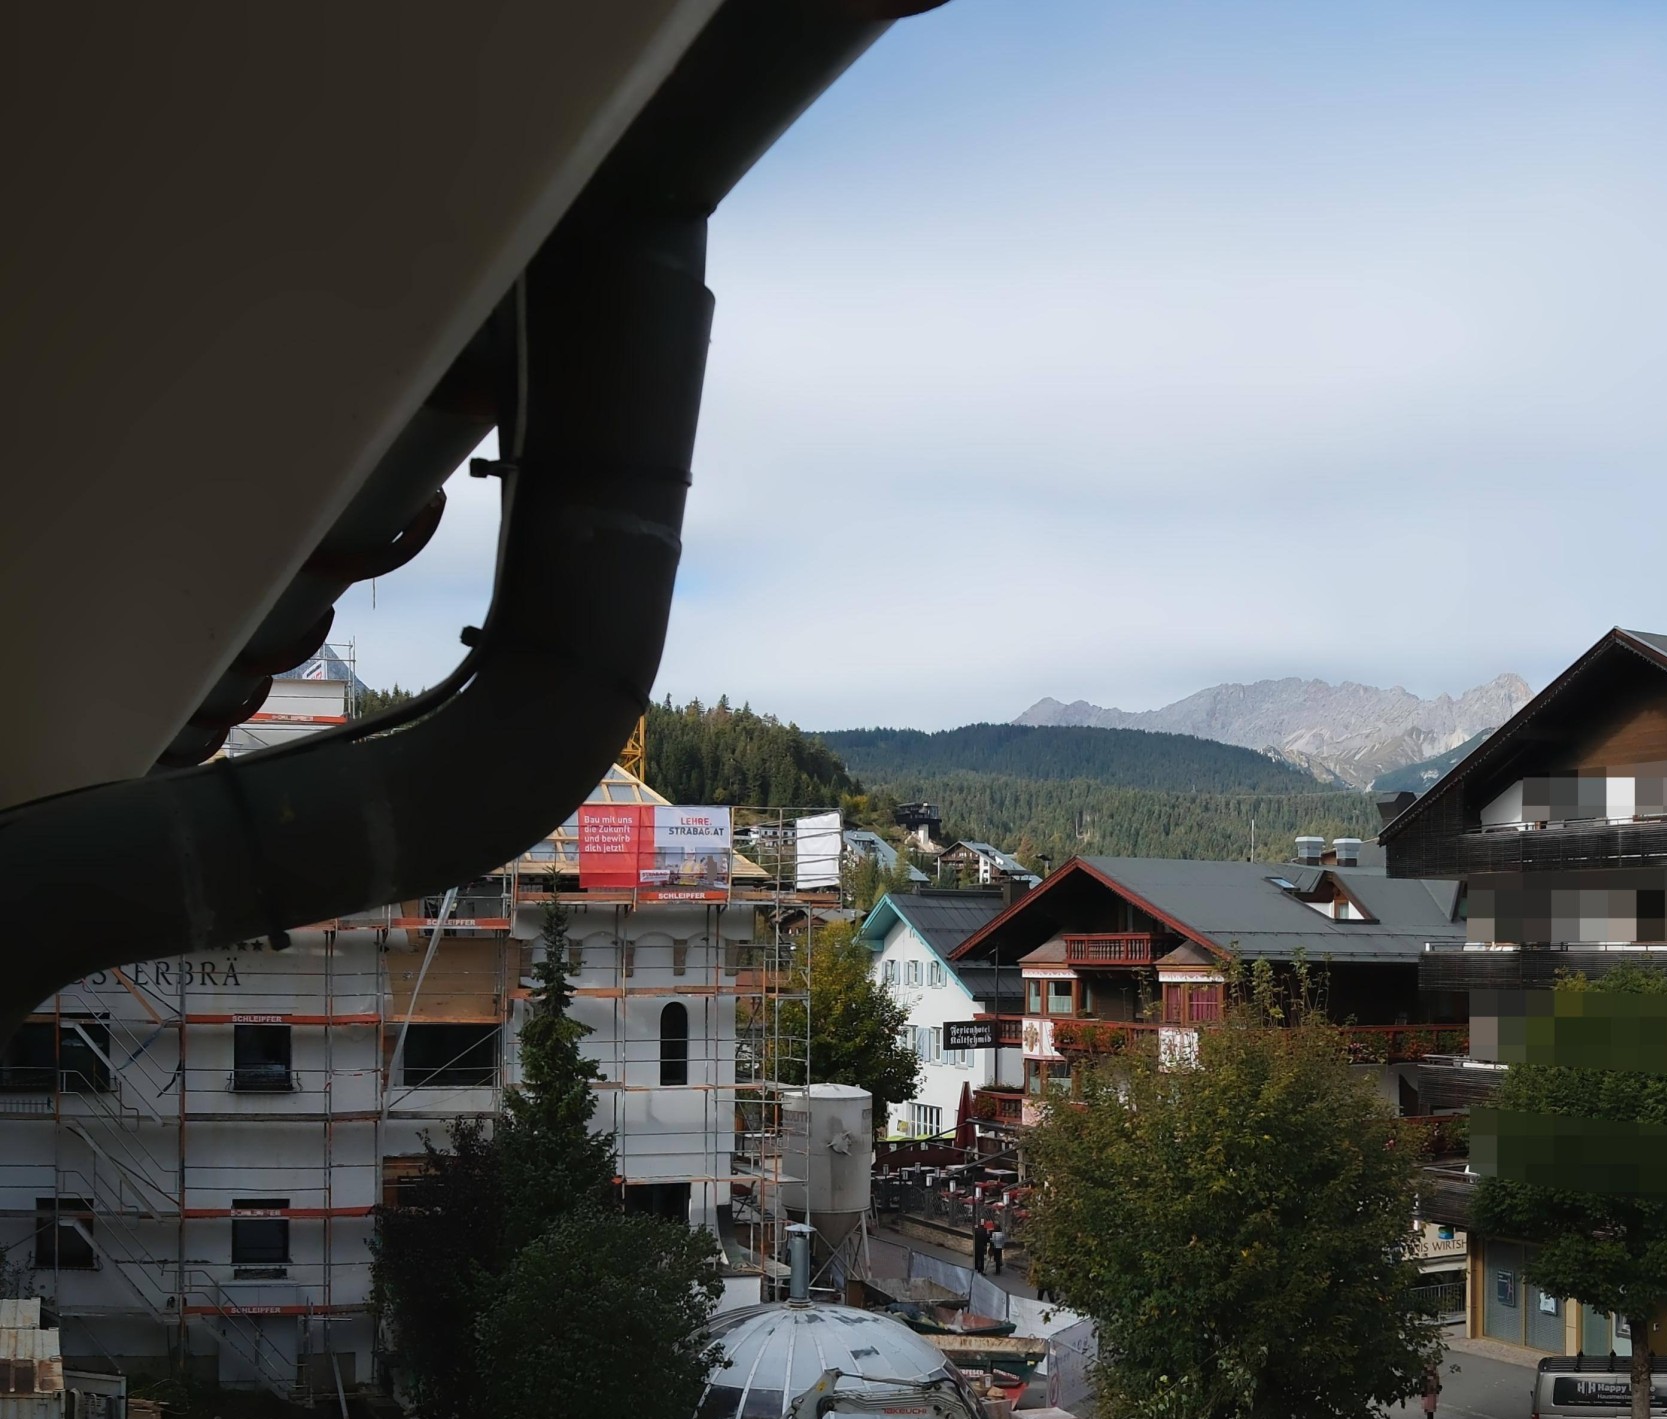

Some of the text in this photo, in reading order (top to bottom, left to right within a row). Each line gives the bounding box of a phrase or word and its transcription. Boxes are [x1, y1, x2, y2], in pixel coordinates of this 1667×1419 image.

[584, 815, 600, 823] Bau
[602, 815, 616, 823] mit
[680, 817, 712, 826] LEHRE.
[584, 825, 630, 833] die Zukunft
[668, 827, 724, 836] STRABAG.AT
[584, 834, 630, 842] und bewirb
[584, 844, 624, 853] dich jetzt!
[658, 892, 706, 900] SCHLEIPFER
[232, 1015, 282, 1023] SCHLEIPFER
[949, 1024, 991, 1037] Ferienhotel
[1598, 1384, 1627, 1393] Happy
